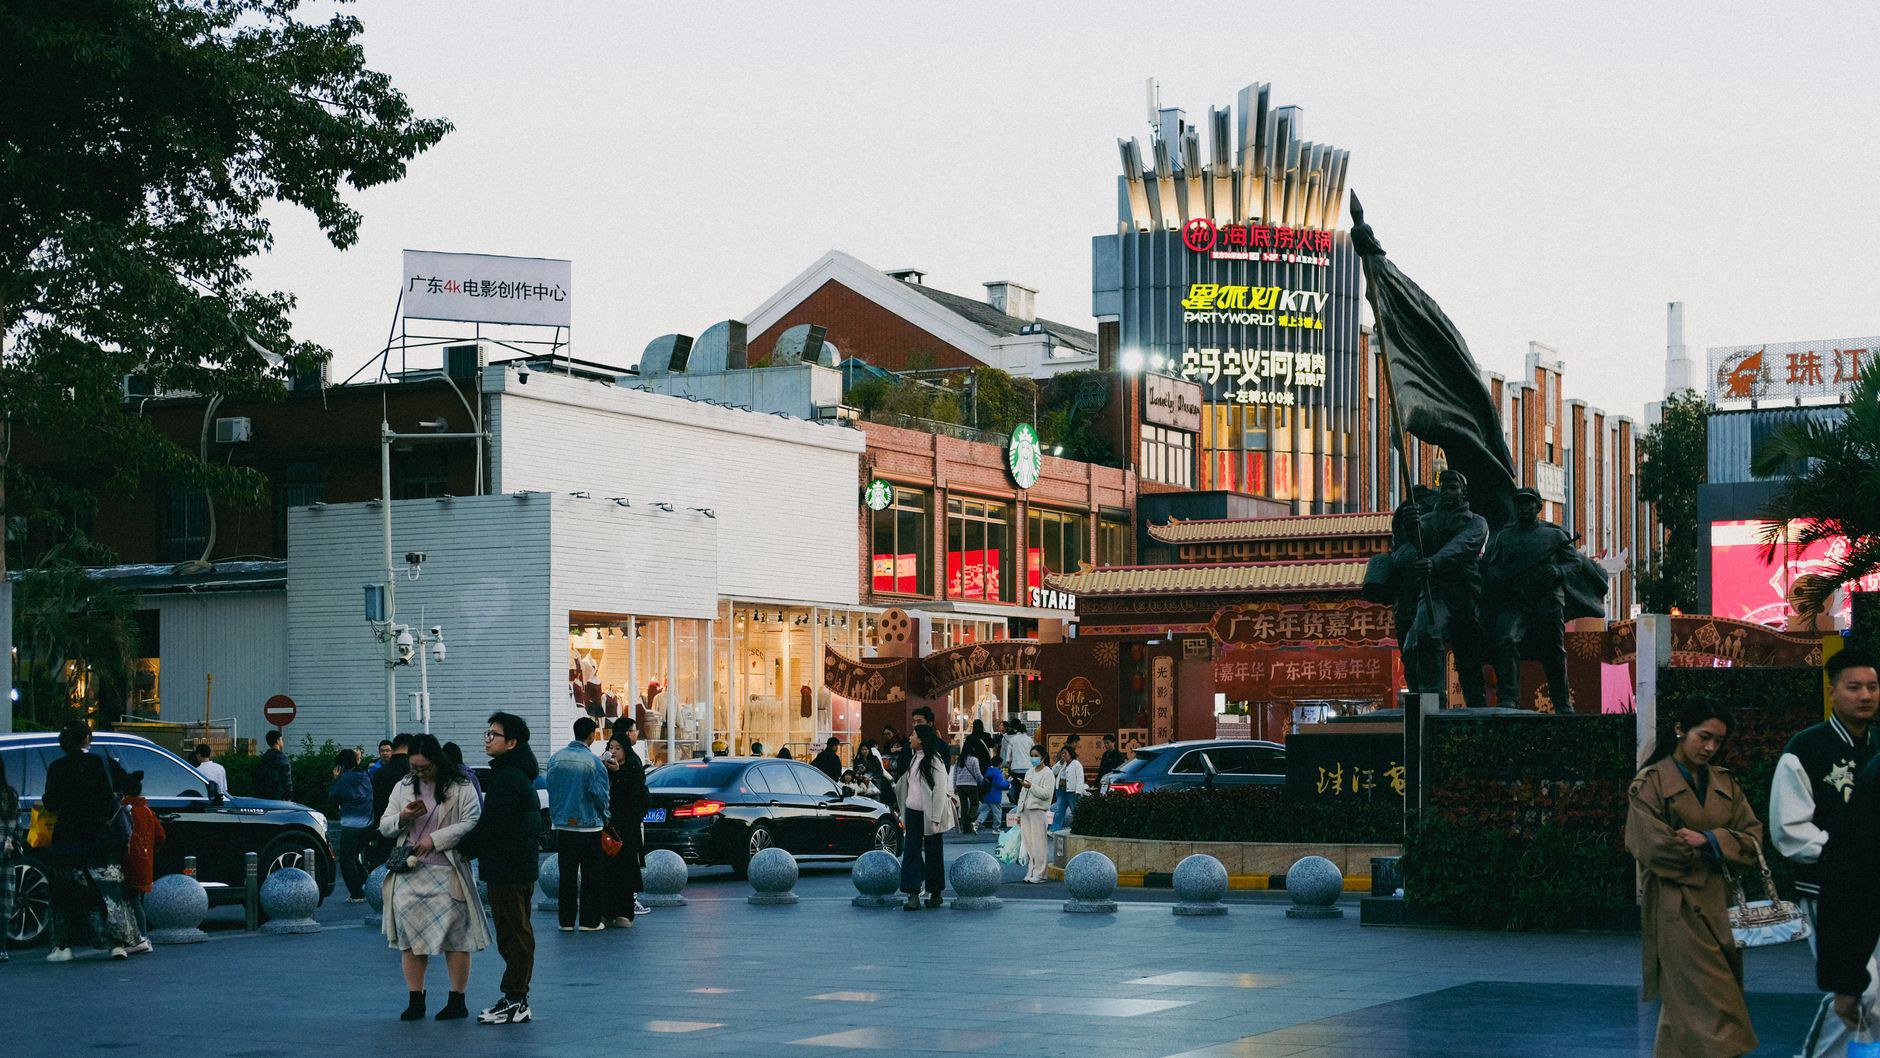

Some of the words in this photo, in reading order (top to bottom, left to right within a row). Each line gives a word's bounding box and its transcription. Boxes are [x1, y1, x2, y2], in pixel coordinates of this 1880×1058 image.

[1222, 224, 1333, 254] 海底捞火锅
[408, 274, 567, 302] 广东4k电影创作中心
[1183, 311, 1276, 327] PARTYWORLD
[1786, 348, 1868, 386] 珠江
[1031, 588, 1076, 610] STARB
[1228, 610, 1396, 640] 广东年货嘉年华
[1270, 658, 1382, 682] 广东年货嘉年华
[1070, 704, 1090, 718] 快乐
